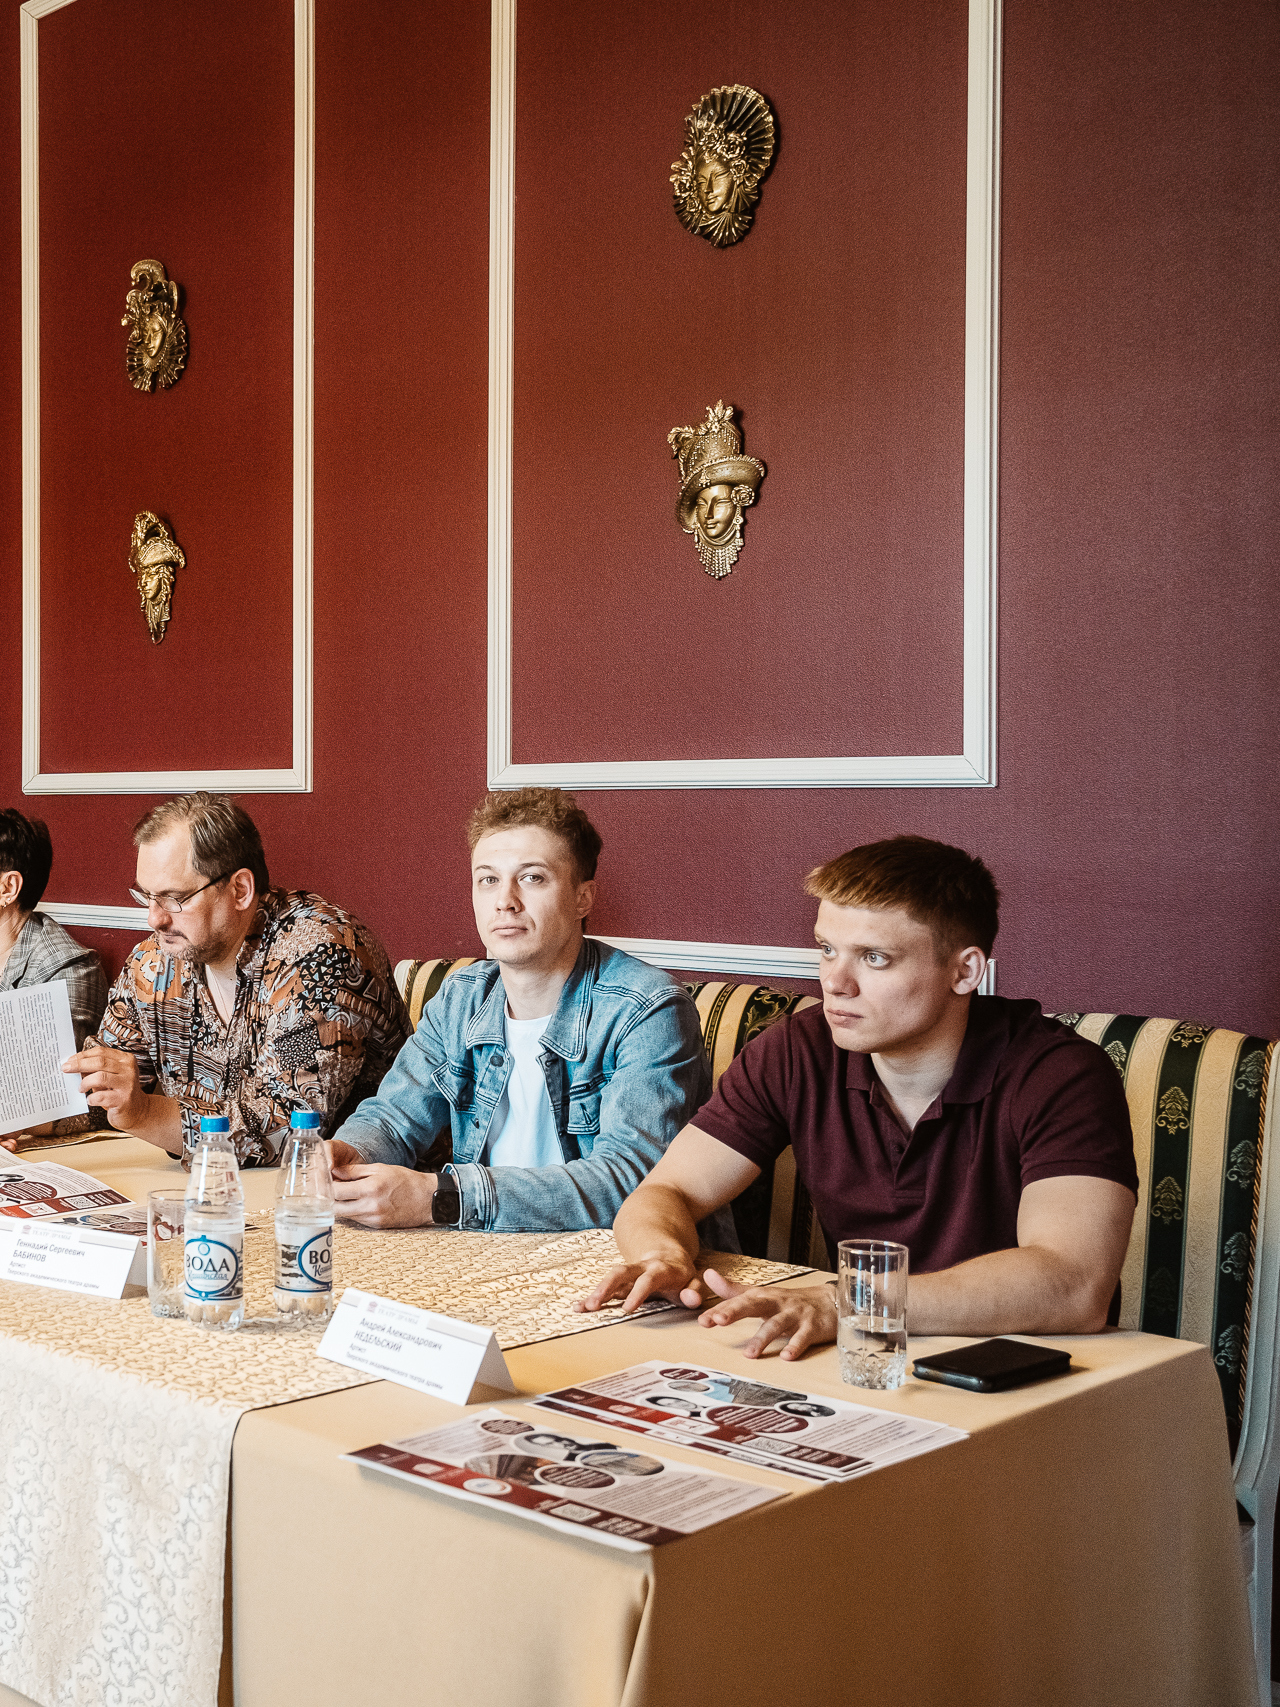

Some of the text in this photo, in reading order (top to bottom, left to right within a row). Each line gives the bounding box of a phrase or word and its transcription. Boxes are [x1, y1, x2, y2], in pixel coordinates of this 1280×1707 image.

[12, 1249, 47, 1262] БАБИНОВ
[16, 1239, 86, 1257] Геннадий Сергеевич
[9, 1261, 27, 1269] Артист
[309, 1249, 332, 1265] ВО
[354, 1330, 403, 1353] НЕДЕЛЬСКИЙ
[359, 1317, 443, 1350] Андрей Александрович
